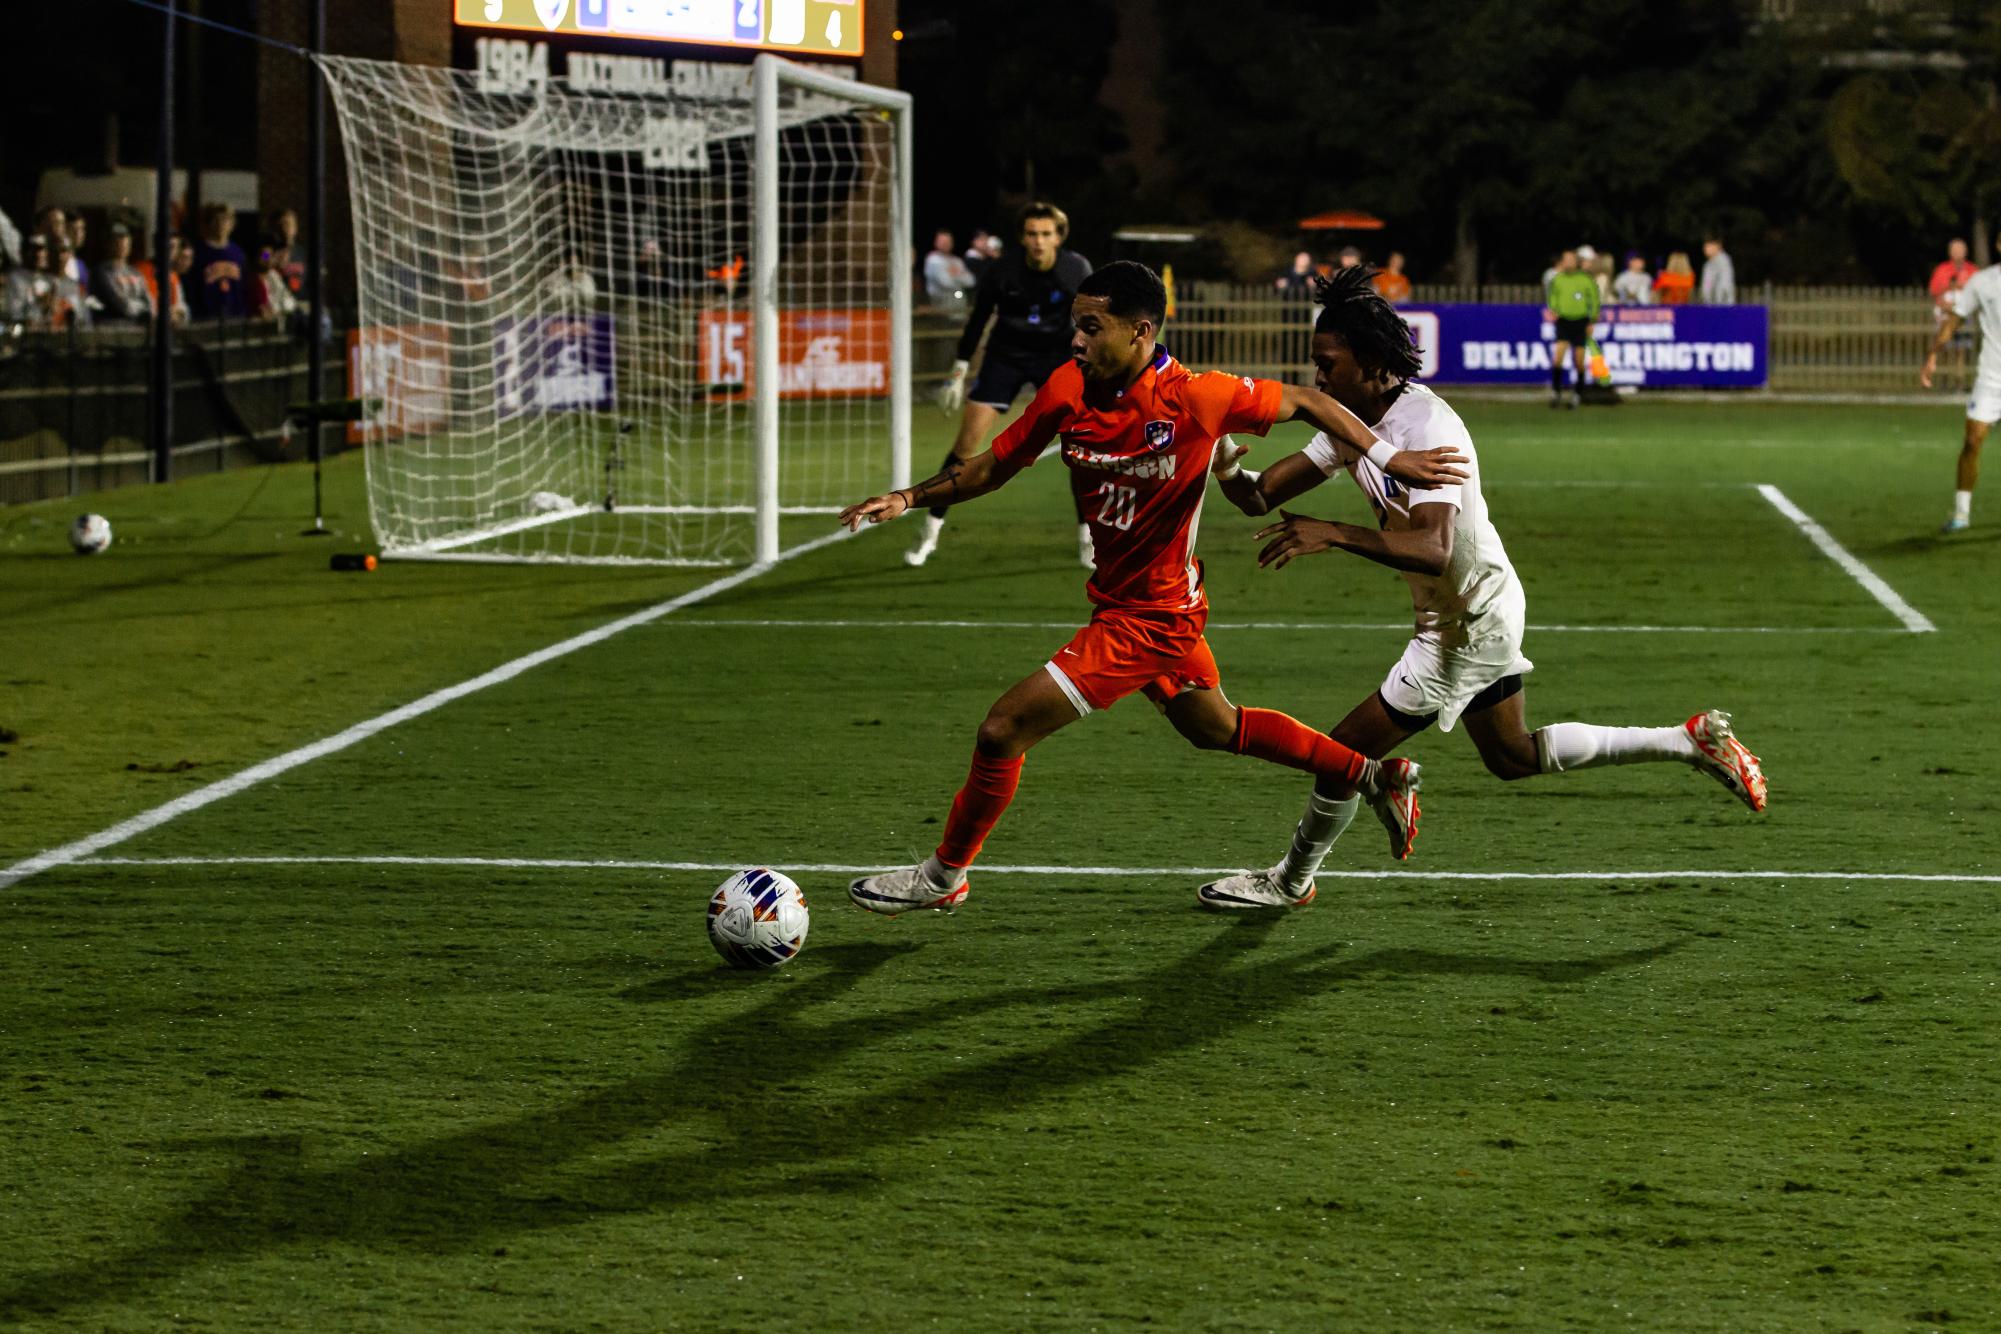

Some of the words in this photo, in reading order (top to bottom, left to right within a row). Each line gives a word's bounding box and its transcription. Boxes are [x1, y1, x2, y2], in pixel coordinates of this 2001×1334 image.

[825, 10, 843, 48] 4
[475, 38, 548, 93] 1984
[709, 323, 745, 385] 15
[1096, 482, 1136, 532] 20
